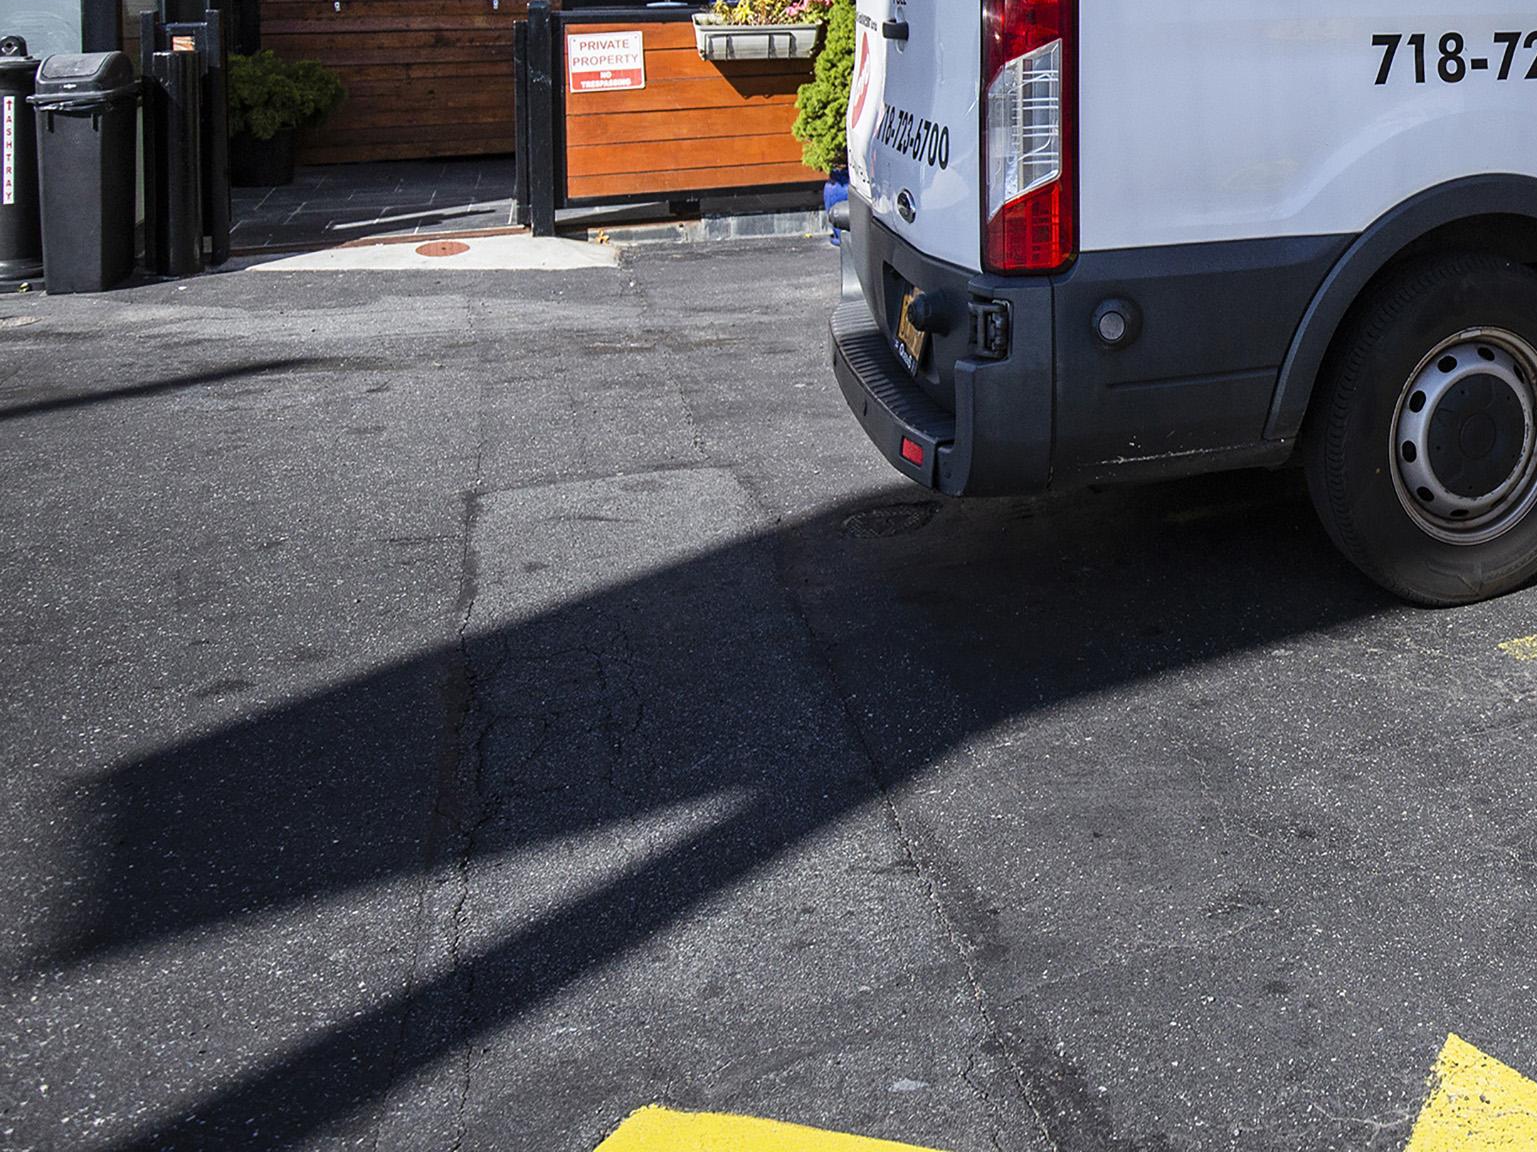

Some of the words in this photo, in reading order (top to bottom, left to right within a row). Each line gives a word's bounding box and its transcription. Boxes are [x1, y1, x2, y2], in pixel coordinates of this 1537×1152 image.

[579, 38, 631, 51] PRIVATE
[572, 53, 639, 66] PROPERTY
[600, 71, 613, 79] NO
